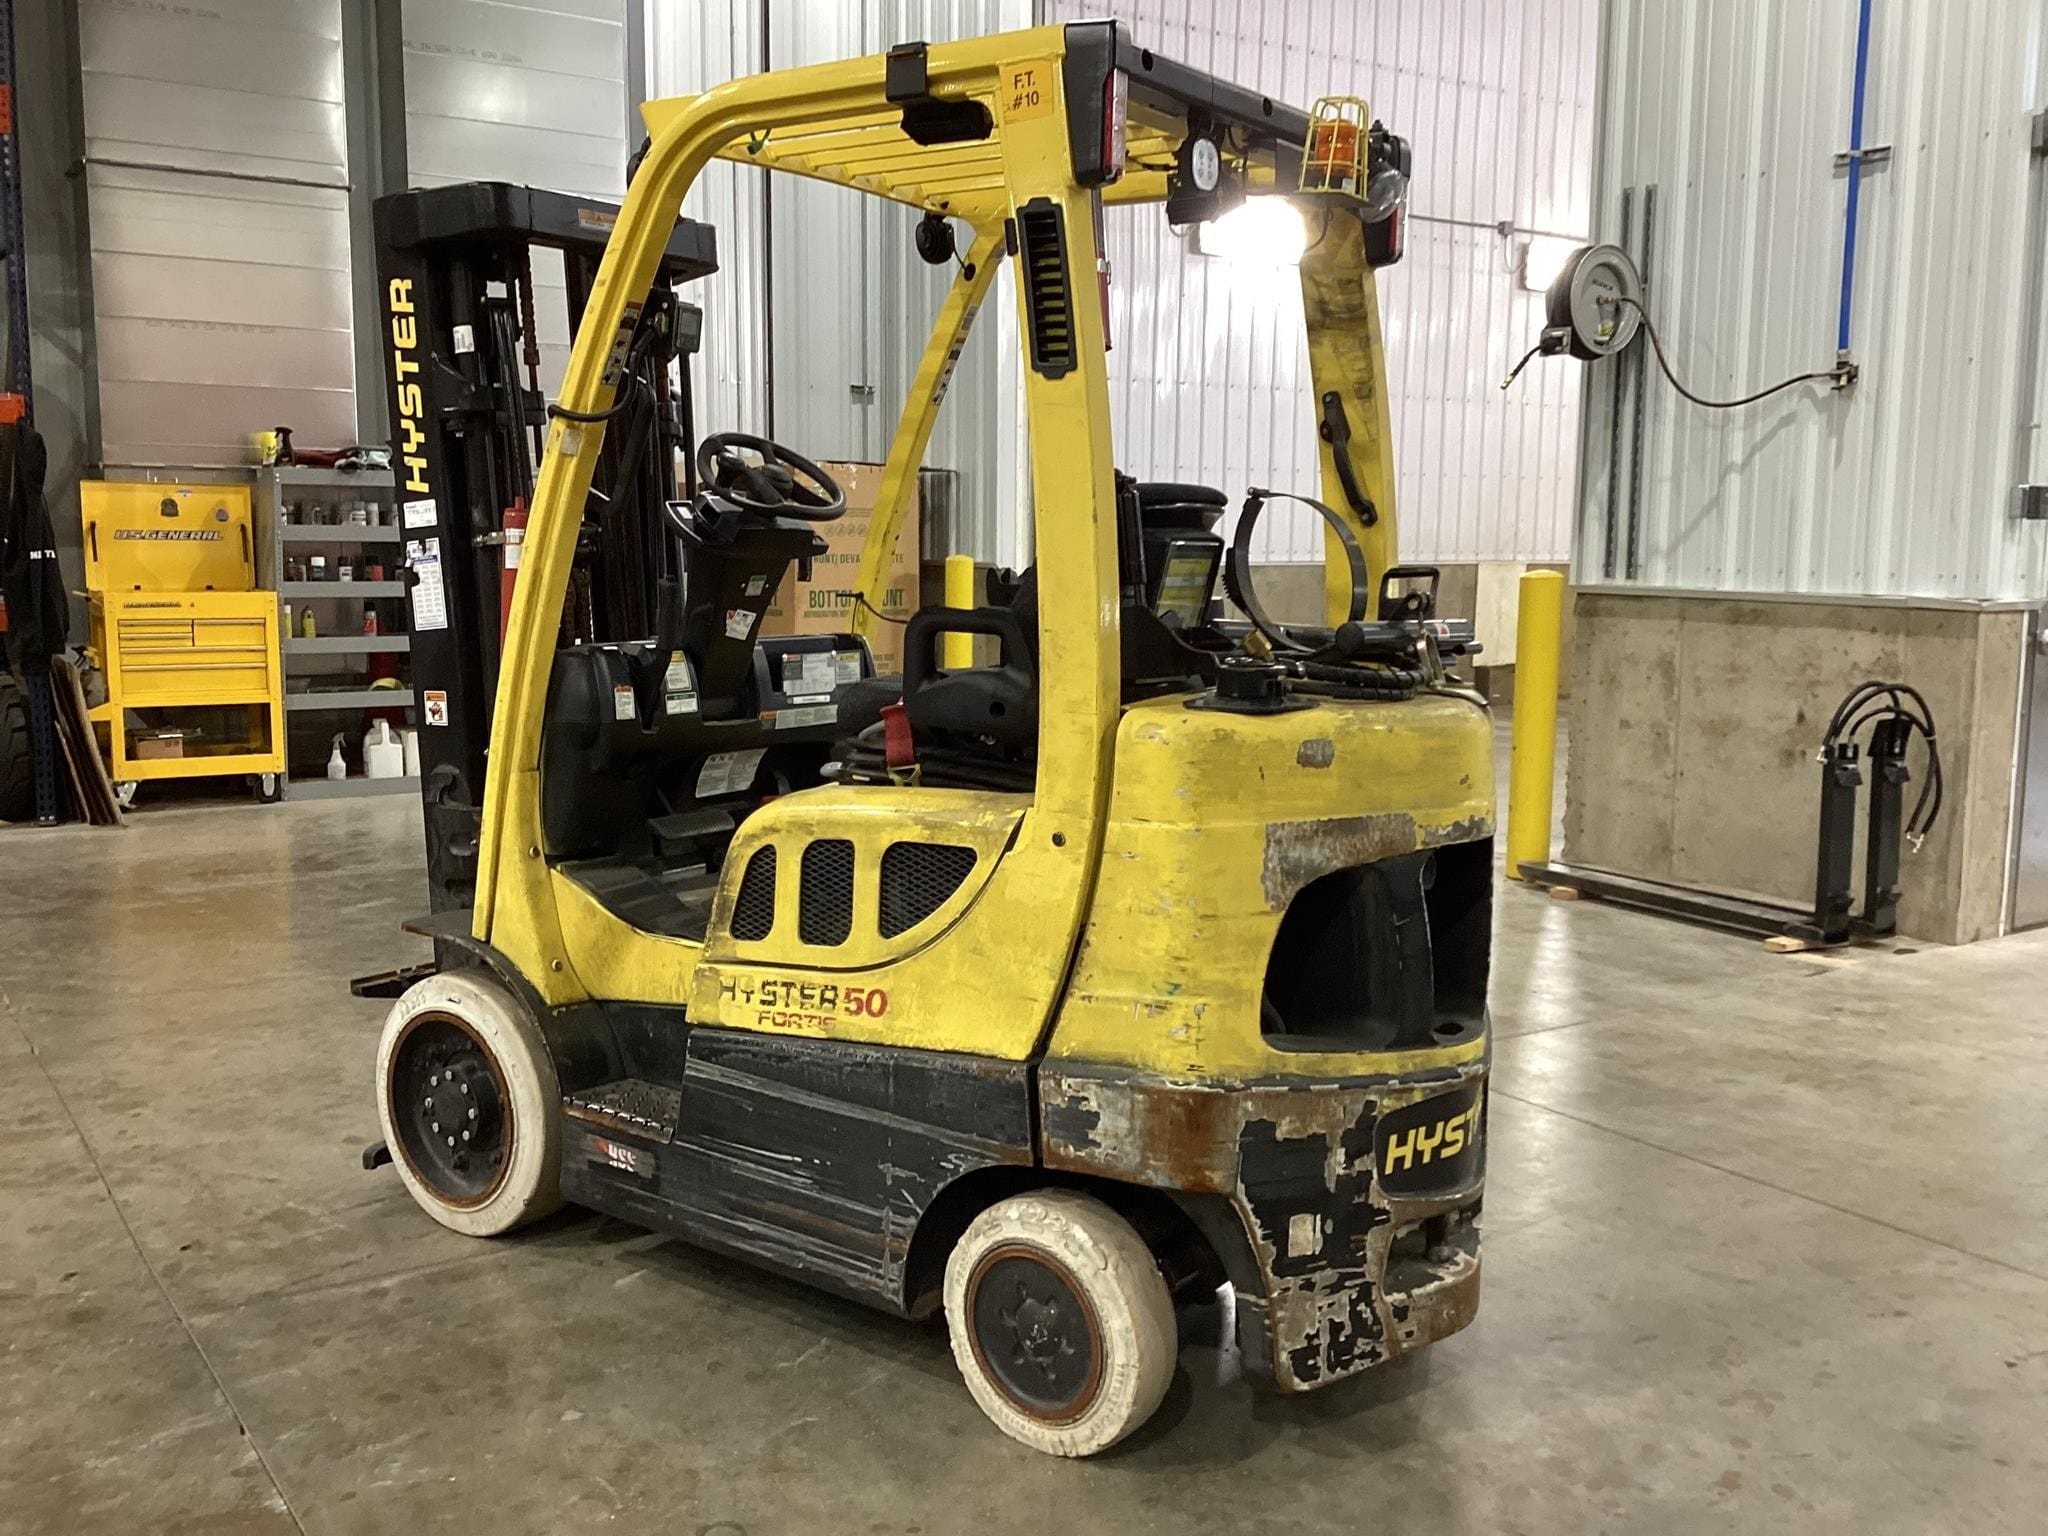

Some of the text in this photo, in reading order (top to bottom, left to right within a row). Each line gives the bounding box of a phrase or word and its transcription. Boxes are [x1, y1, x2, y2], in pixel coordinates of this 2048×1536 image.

[1014, 70, 1036, 90] F.T.
[1012, 90, 1040, 111] #10
[389, 278, 430, 493] HYSTER
[839, 553, 861, 565] DEVA
[719, 976, 888, 1018] HYSTER 50
[1384, 1105, 1479, 1176] HYST
